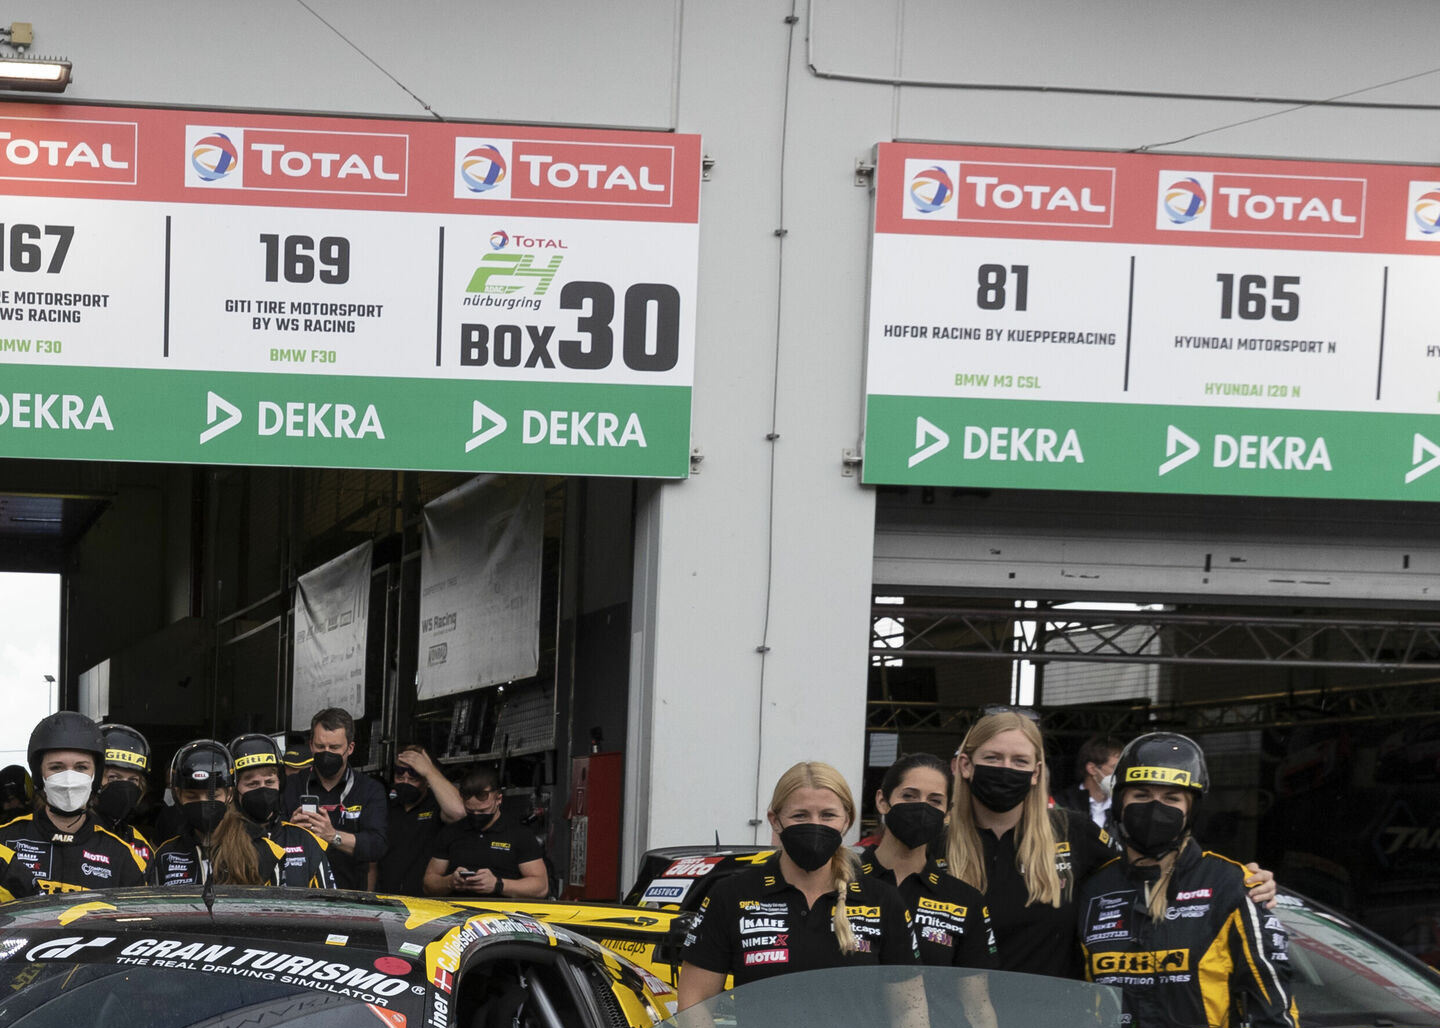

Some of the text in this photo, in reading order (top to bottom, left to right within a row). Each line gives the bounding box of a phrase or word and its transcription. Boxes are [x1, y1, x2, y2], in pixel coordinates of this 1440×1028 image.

[251, 143, 399, 180] TOTAL
[520, 155, 664, 191] TOTAL
[966, 176, 1106, 212] TOTAL
[1219, 187, 1356, 223] TOTAL
[512, 236, 568, 248] TOTAL
[260, 234, 350, 284] 169
[977, 264, 1028, 311] 81
[15, 292, 109, 307] MOTORSPORT
[463, 295, 541, 310] nürburgring
[1217, 273, 1300, 321] 165
[0, 308, 23, 320] WS
[29, 309, 80, 323] RACING
[226, 300, 383, 317] GITI TIRE MOTORSPORT
[253, 317, 355, 333] BY WS RACING
[460, 281, 680, 372] BOX 30
[884, 325, 1116, 345] HOFOR RACING BY KUEPPERRACING
[36, 340, 61, 353] F30
[1175, 336, 1336, 353] HYUNDAI MOTORSPORT N
[270, 349, 336, 363] BMW F30
[955, 373, 1041, 389] BMW M3 CSL
[1205, 383, 1263, 396] HYUNDAI
[1292, 386, 1300, 397] N
[258, 401, 385, 439] DEKRA
[523, 410, 647, 447] DEKRA
[964, 426, 1084, 463] DEKRA
[1213, 434, 1332, 471] DEKRA
[1130, 770, 1166, 779] Giti
[649, 888, 679, 896] BASTUCK
[746, 951, 786, 964] MOTUL
[1097, 955, 1148, 972] Giti
[120, 939, 410, 998] GRAN TURISMO
[115, 955, 389, 1007] THE REAL DRIVING SIMULATOR
